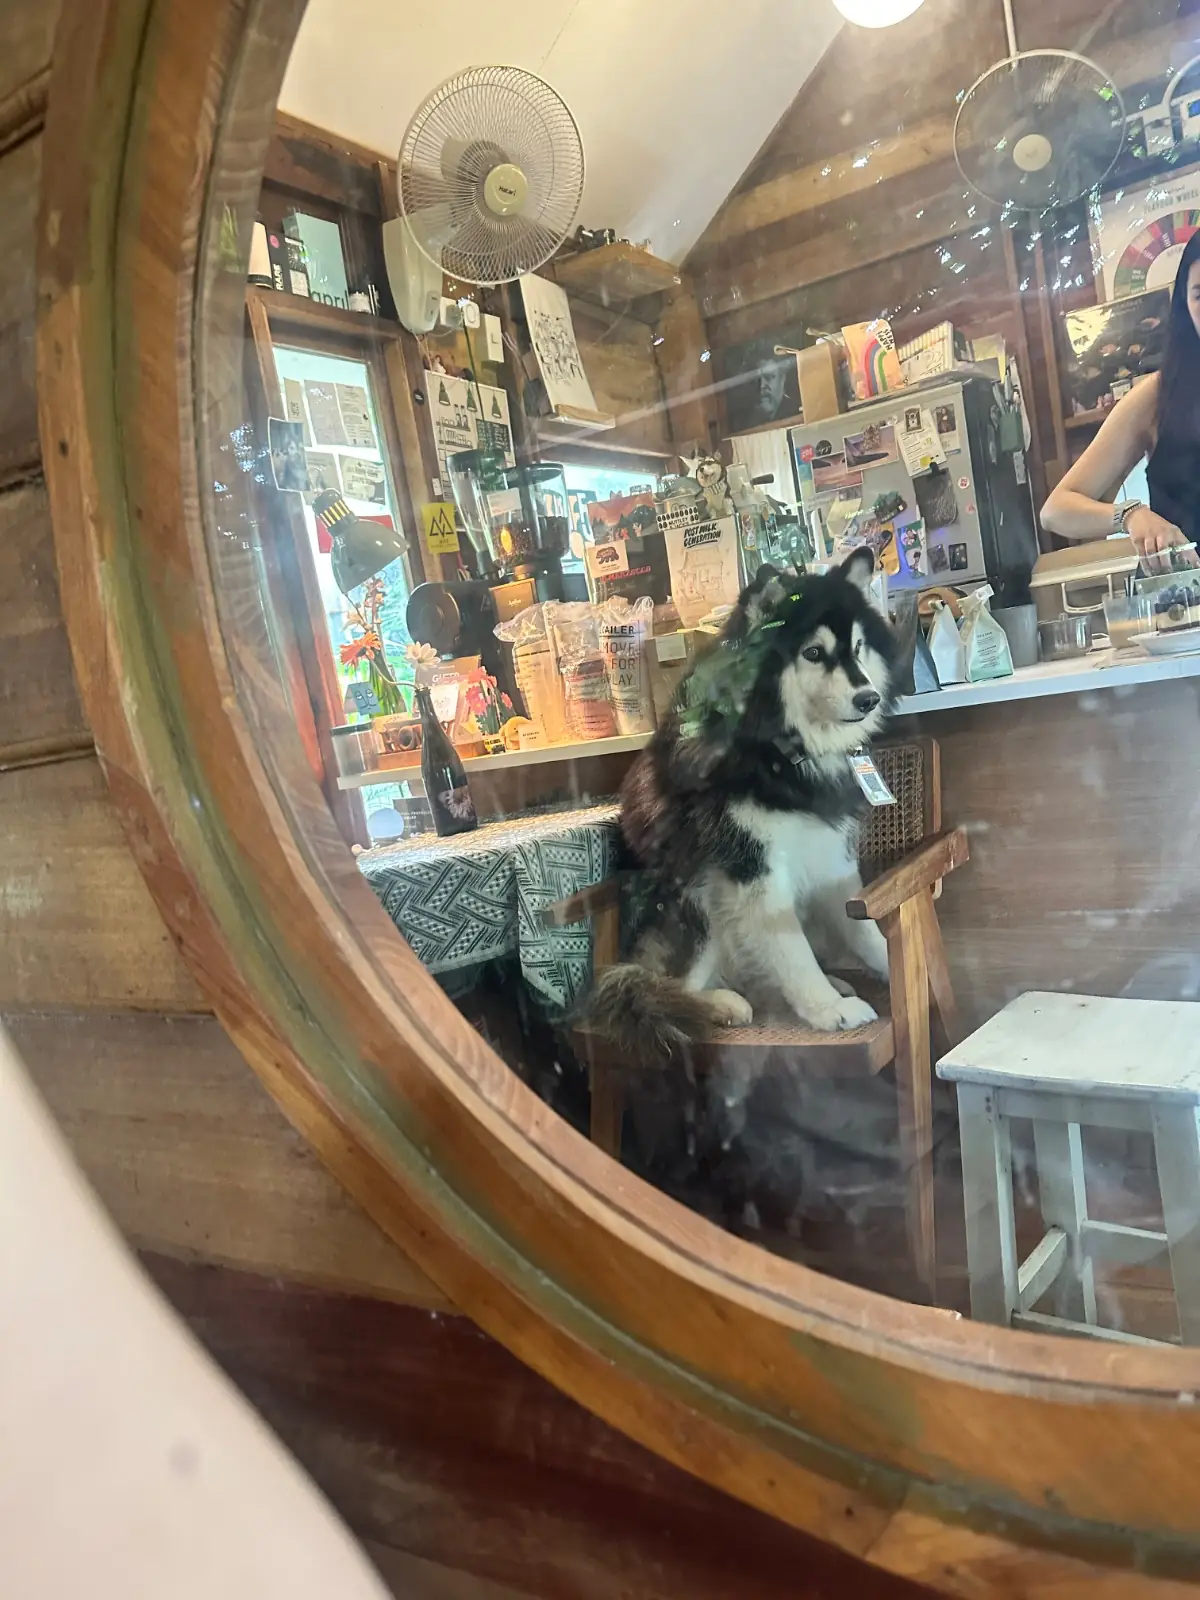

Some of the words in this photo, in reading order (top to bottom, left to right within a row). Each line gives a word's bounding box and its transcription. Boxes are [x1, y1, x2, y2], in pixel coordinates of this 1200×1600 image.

[273, 263, 284, 291] RARE
[310, 289, 350, 311] april
[683, 525, 700, 539] POST
[699, 522, 718, 534] MILK
[683, 530, 722, 548] GENERATION
